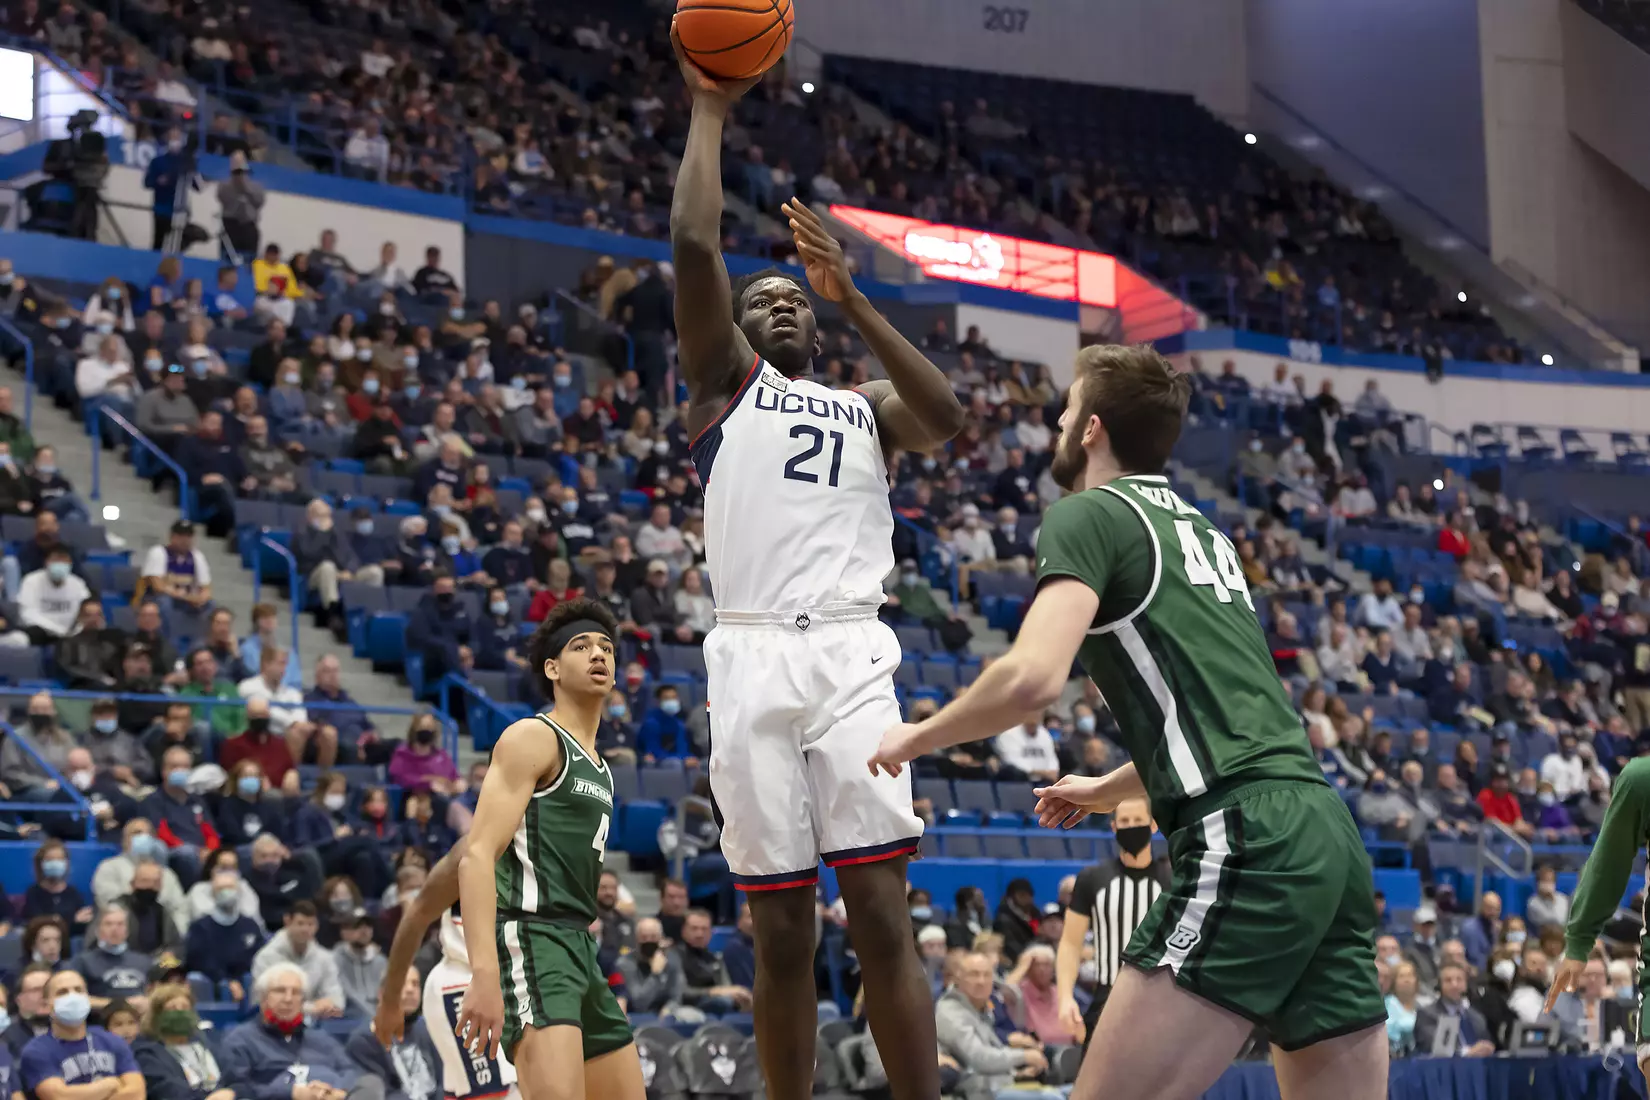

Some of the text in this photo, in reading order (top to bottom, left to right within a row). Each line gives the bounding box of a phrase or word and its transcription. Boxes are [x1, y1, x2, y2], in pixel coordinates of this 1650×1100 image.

[983, 5, 1030, 33] 207
[755, 386, 874, 437] UCONN
[784, 424, 844, 487] 21
[1173, 519, 1256, 612] 44
[1167, 924, 1199, 951] B
